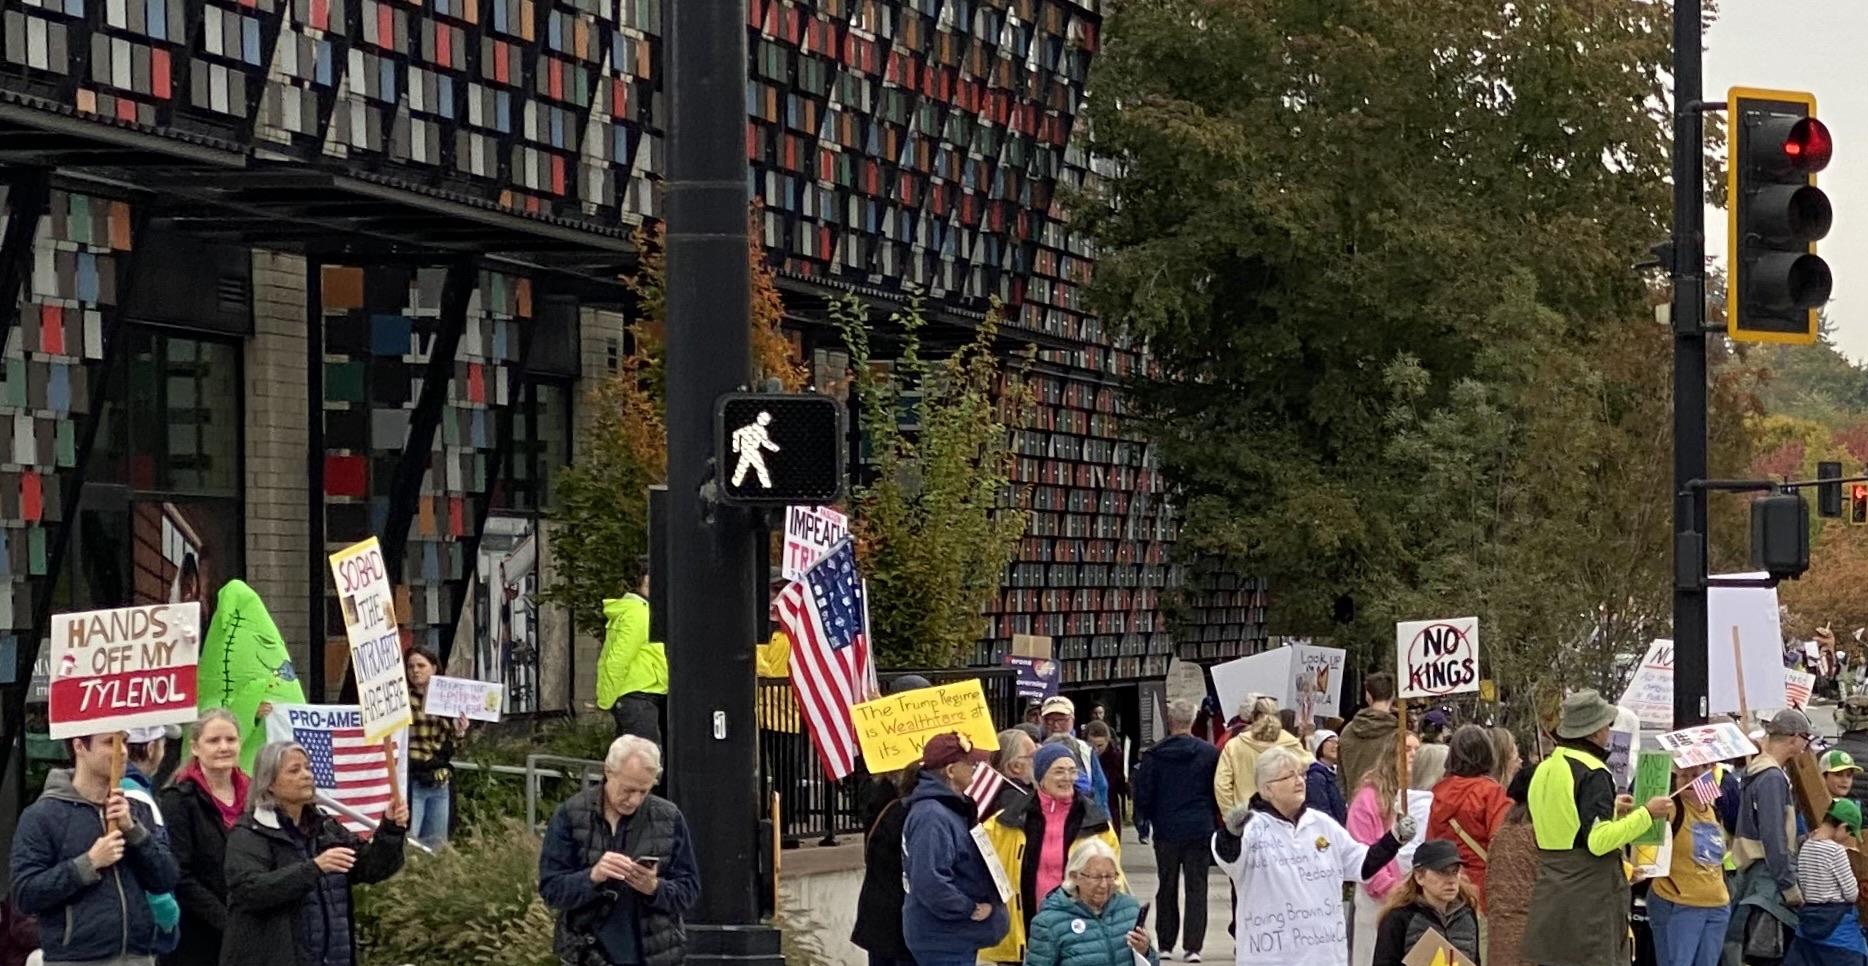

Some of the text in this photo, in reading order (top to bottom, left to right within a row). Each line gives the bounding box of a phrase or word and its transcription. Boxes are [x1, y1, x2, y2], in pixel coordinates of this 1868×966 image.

[67, 605, 171, 649] HANDS
[358, 593, 385, 631] THE
[91, 639, 179, 675] OFF MY
[352, 630, 401, 684] INTROVERTS
[1301, 650, 1328, 665] Look
[1423, 627, 1460, 658] NO
[1408, 657, 1475, 692] KINGS
[78, 673, 186, 713] TYLENOL
[363, 677, 408, 726] ARE HERE
[857, 689, 981, 721] The Trump Regime
[865, 727, 879, 739] is
[970, 706, 985, 719] at
[879, 742, 900, 760] its
[1244, 912, 1286, 929] Having
[1286, 902, 1325, 921] Brown
[1249, 930, 1284, 953] NOT
